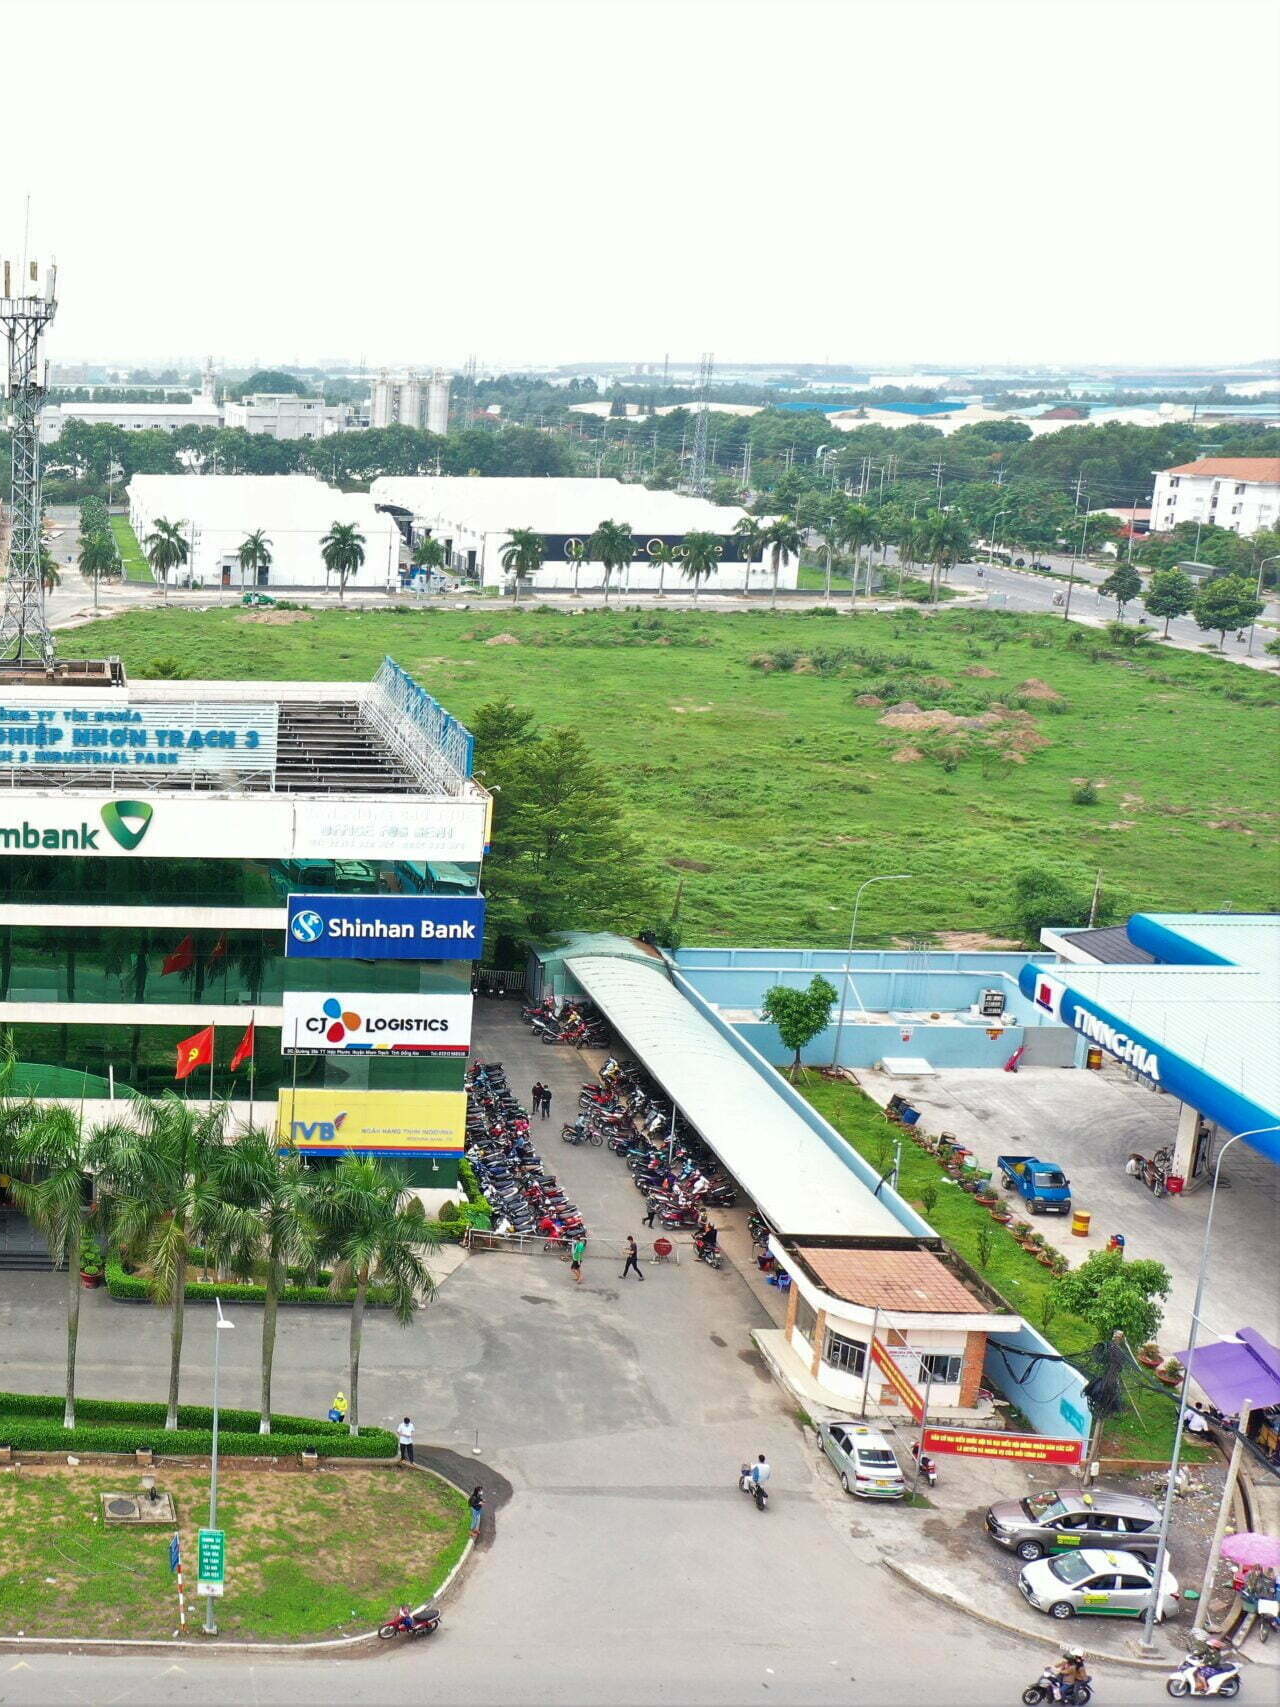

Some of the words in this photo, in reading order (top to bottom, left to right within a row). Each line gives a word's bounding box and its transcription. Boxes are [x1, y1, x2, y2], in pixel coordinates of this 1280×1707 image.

[155, 729, 236, 750] TRẠCH
[244, 730, 260, 749] 3
[19, 750, 28, 763] 3
[35, 751, 128, 764] INDUSTRIAL
[135, 752, 178, 764] PARK
[328, 917, 414, 938] Shinhan
[421, 919, 476, 939] Bank
[306, 1017, 329, 1034] CJ
[366, 1018, 449, 1033] LOGISTICS
